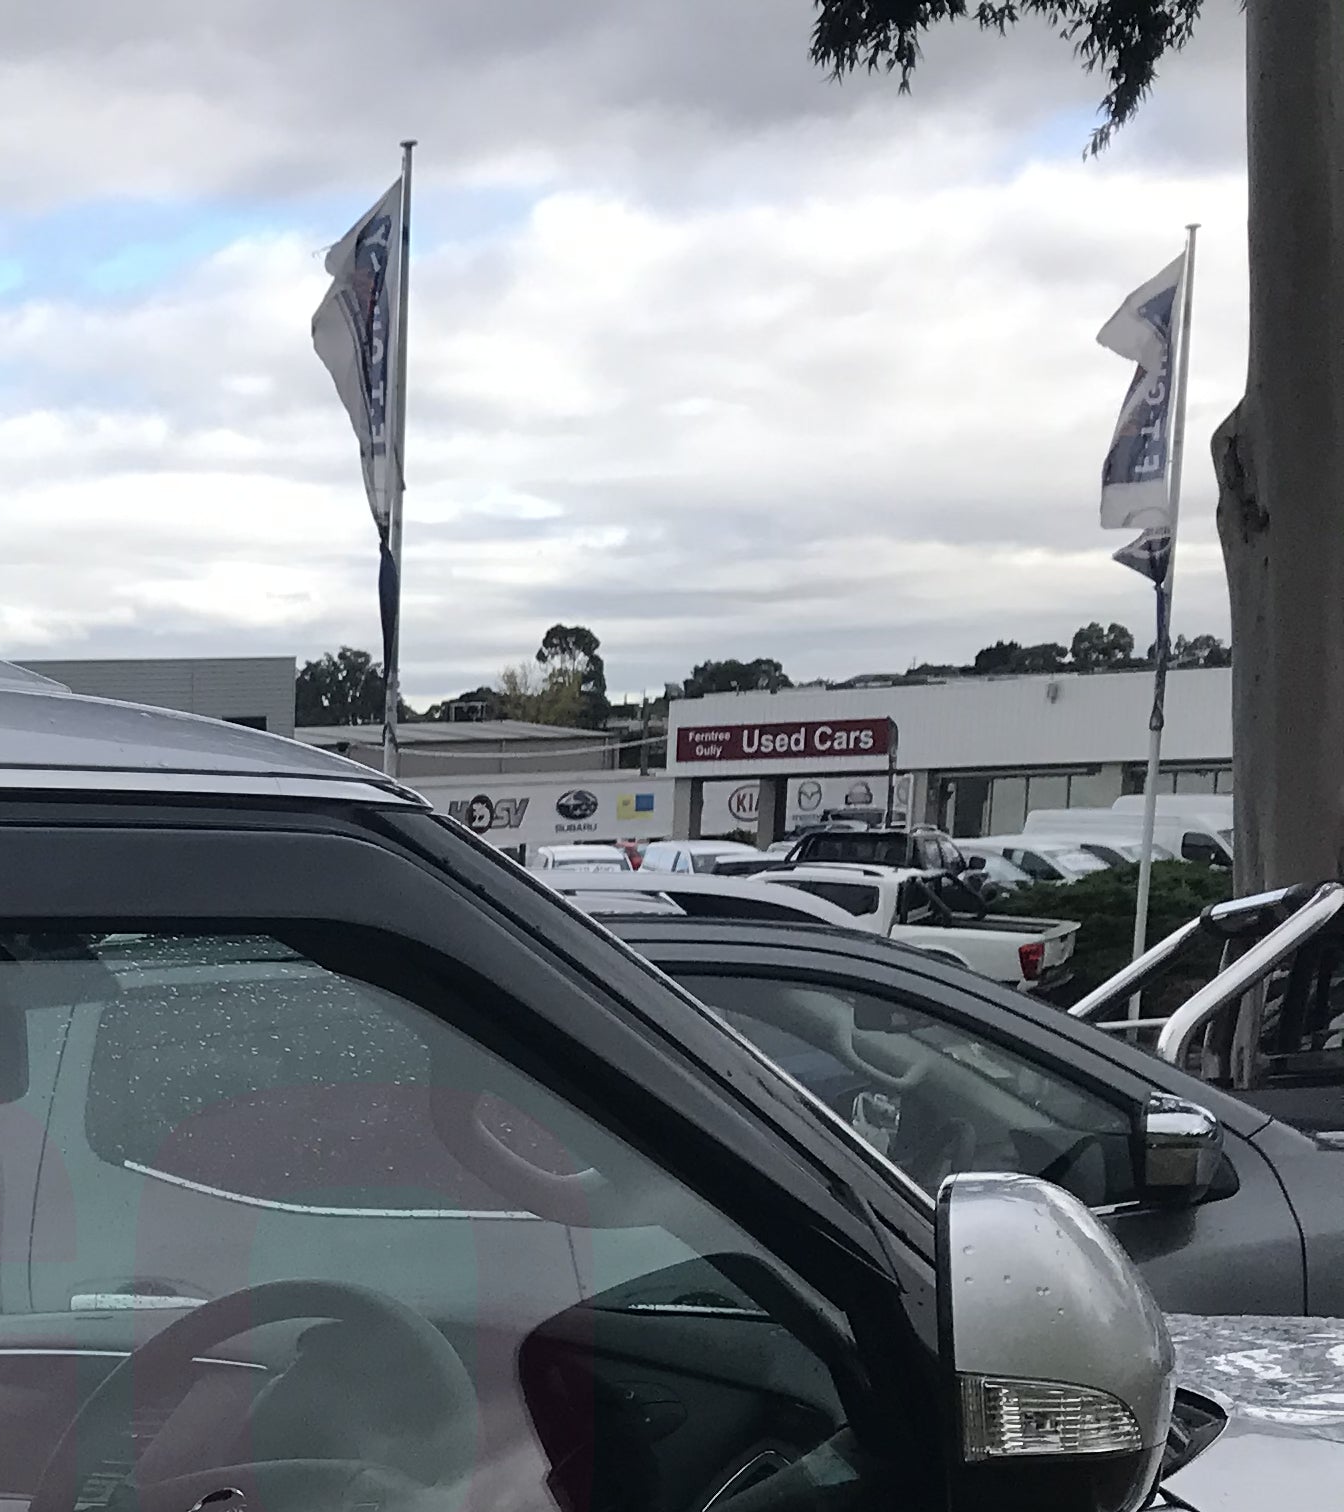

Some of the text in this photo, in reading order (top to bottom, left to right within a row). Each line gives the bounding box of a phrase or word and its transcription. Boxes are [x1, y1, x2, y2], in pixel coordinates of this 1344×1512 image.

[688, 731, 731, 743] Ferntree
[742, 725, 874, 754] Used Cars
